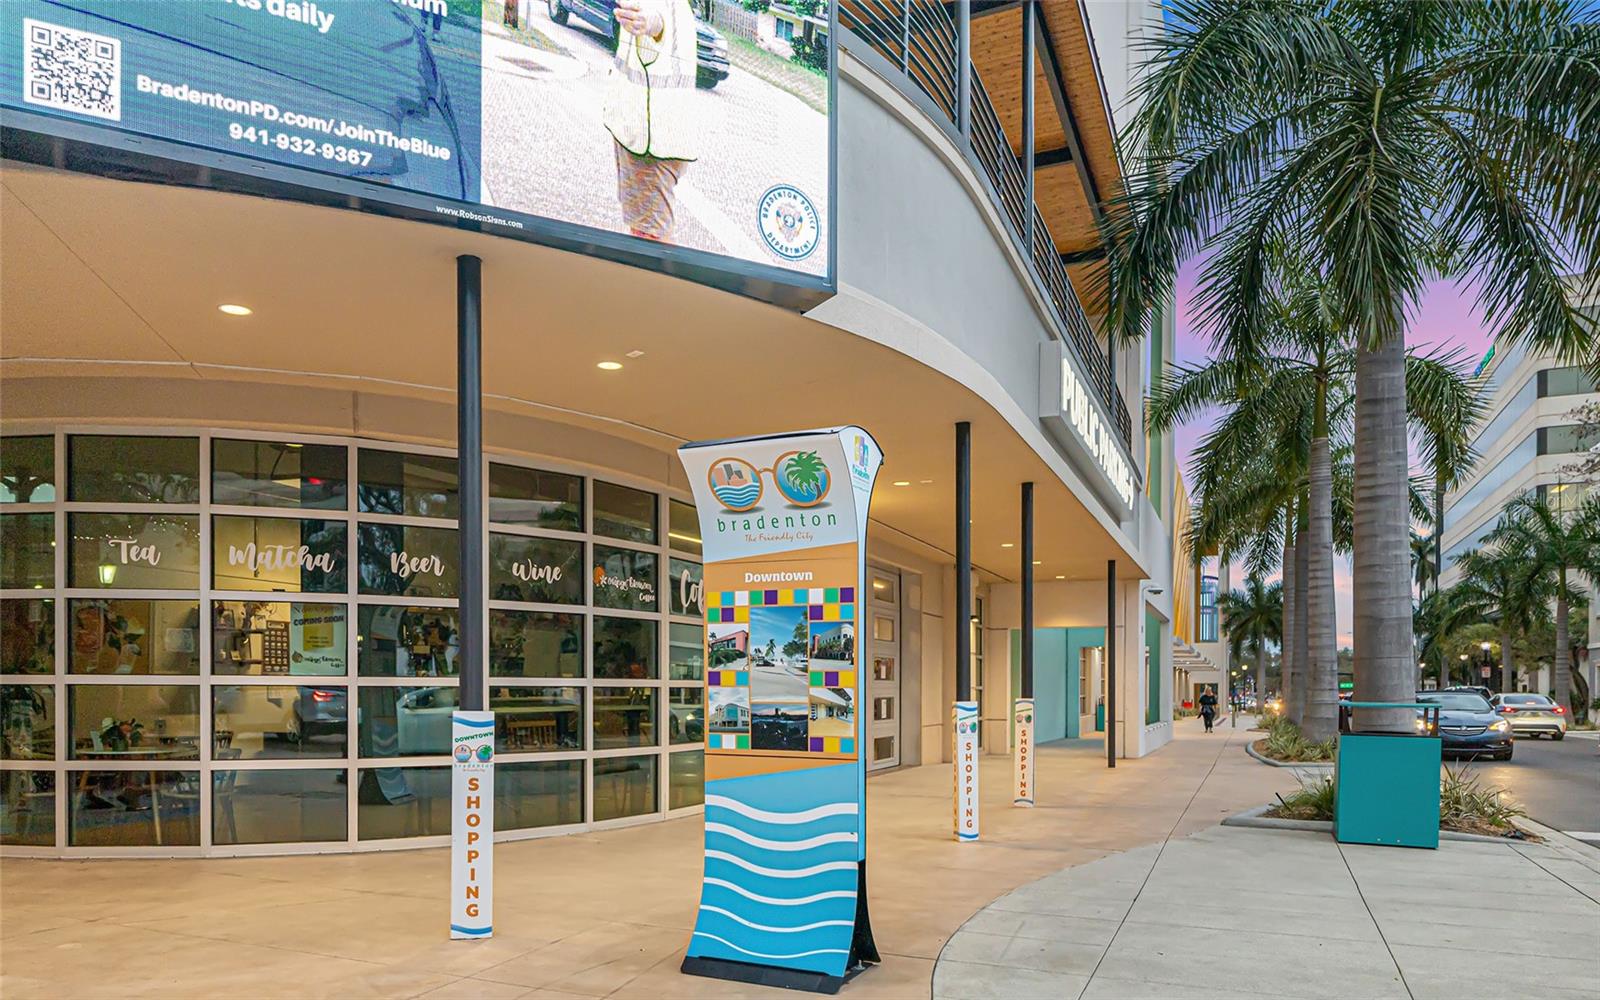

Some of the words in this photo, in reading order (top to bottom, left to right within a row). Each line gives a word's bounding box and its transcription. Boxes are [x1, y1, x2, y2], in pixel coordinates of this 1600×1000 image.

[266, 0, 335, 33] daily
[136, 74, 451, 161] BradentonPD.com/JoinTheBlue
[228, 122, 373, 167] 941-932-9367
[1062, 357, 1099, 458] PUBLIC
[716, 512, 838, 533] bradenton
[744, 533, 757, 543] The
[759, 531, 794, 542] Friendly
[796, 531, 814, 541] City
[108, 538, 162, 567] Tea
[228, 542, 336, 574] Matcha
[390, 551, 445, 578] Beer
[511, 558, 563, 584] Wine
[744, 571, 814, 584] Downtown
[639, 592, 656, 603] Coffee
[454, 730, 494, 743] DOWNTOWN
[965, 742, 973, 828] SHOPPING
[466, 777, 481, 918] SHOPPING
